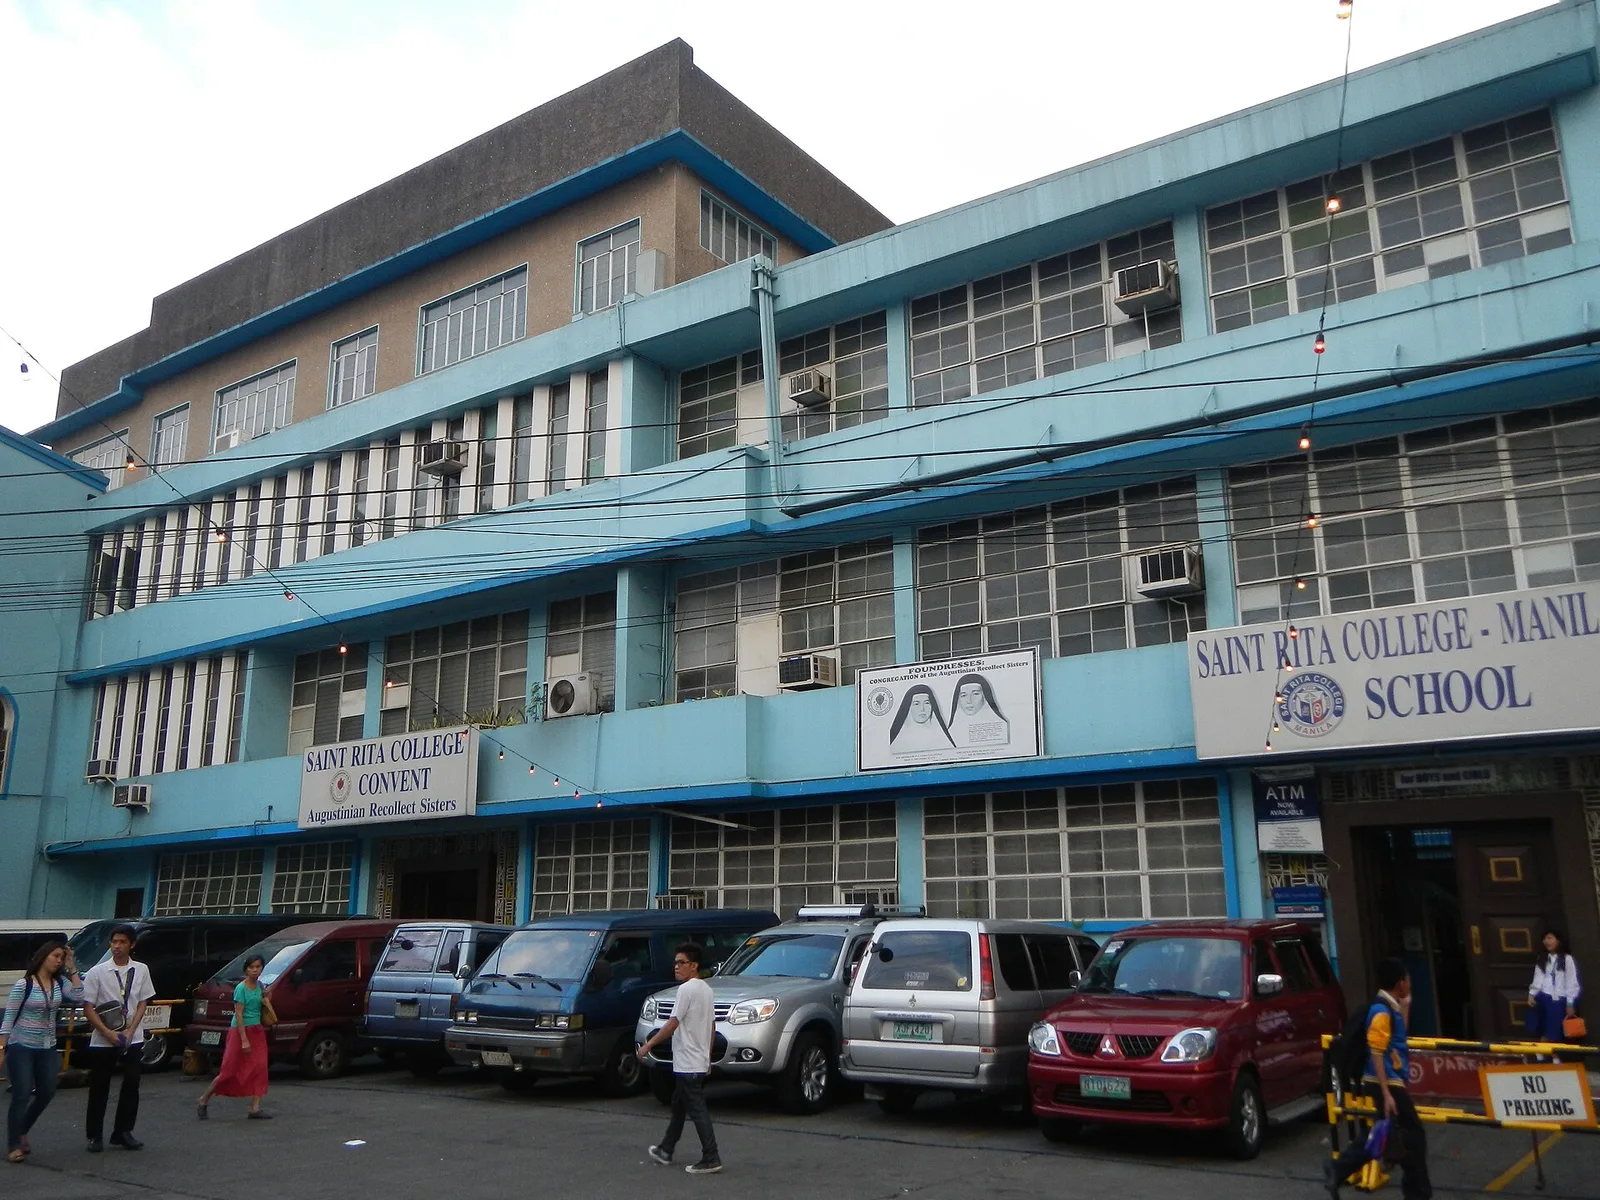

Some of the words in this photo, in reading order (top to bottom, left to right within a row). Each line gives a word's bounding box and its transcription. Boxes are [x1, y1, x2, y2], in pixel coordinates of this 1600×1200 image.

[1196, 633, 1266, 679] SAINT
[1273, 625, 1337, 670] RITA
[1342, 607, 1473, 662] COLLEGE
[869, 673, 919, 685] CONGREGATION
[939, 667, 976, 676] Augustinian
[977, 663, 1005, 672] Recollect
[1006, 661, 1029, 669] Sisters
[908, 660, 985, 674] FOUNDRESSES:
[1290, 675, 1311, 689] RITA
[1313, 675, 1343, 711] COLLEGE
[1364, 665, 1532, 721] SCHOOL
[1293, 722, 1333, 735] MANILA
[306, 747, 348, 773] SAINT
[351, 742, 385, 767] RITA
[391, 732, 465, 763] COLLEGE
[359, 767, 432, 796] CONVENT
[1266, 785, 1306, 801] ATM
[307, 805, 365, 825] Augustinian
[369, 801, 416, 817] Recollect
[420, 798, 457, 814] Sisters
[1269, 809, 1305, 817] AVAILABLE
[1277, 801, 1296, 809] NOW
[1521, 1075, 1548, 1094] NO
[1503, 1098, 1575, 1117] PARKING
